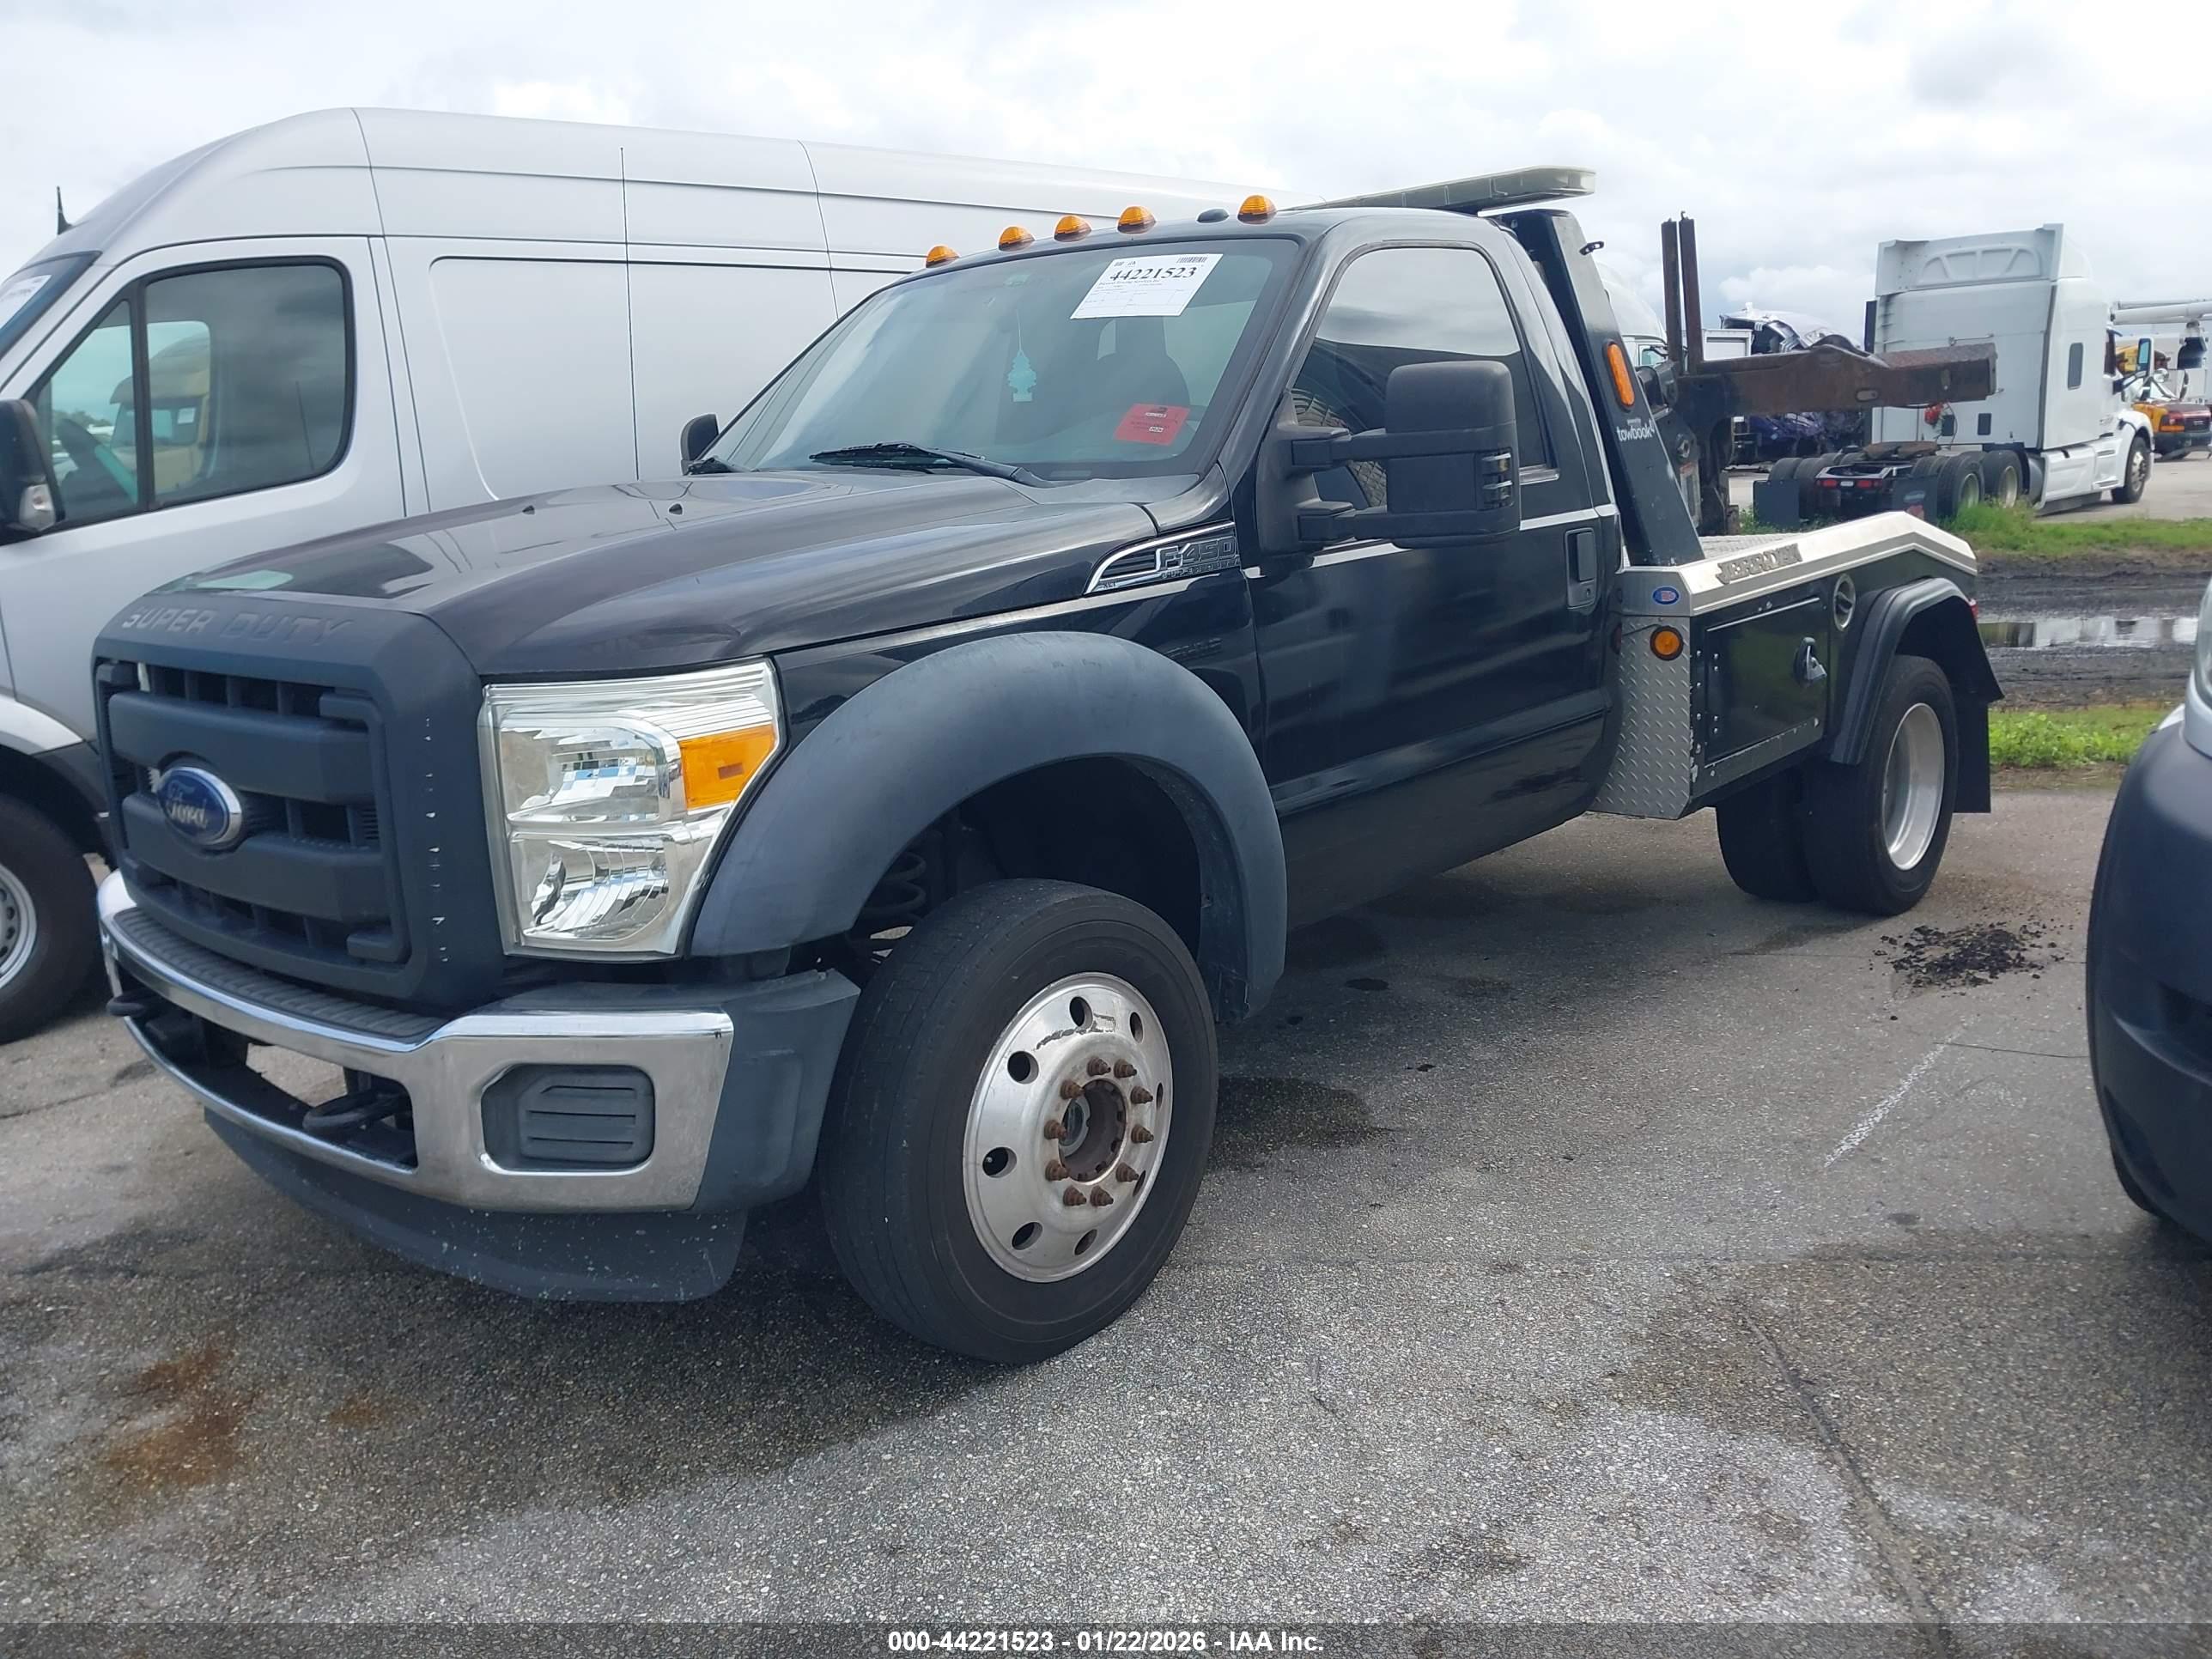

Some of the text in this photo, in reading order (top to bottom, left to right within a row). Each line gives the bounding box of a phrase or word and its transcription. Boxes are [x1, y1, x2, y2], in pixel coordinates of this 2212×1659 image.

[1109, 267, 1198, 281] 44221523
[1616, 422, 1653, 441] towbook
[121, 605, 354, 647] SUPER DUTY
[165, 781, 210, 830] Ford
